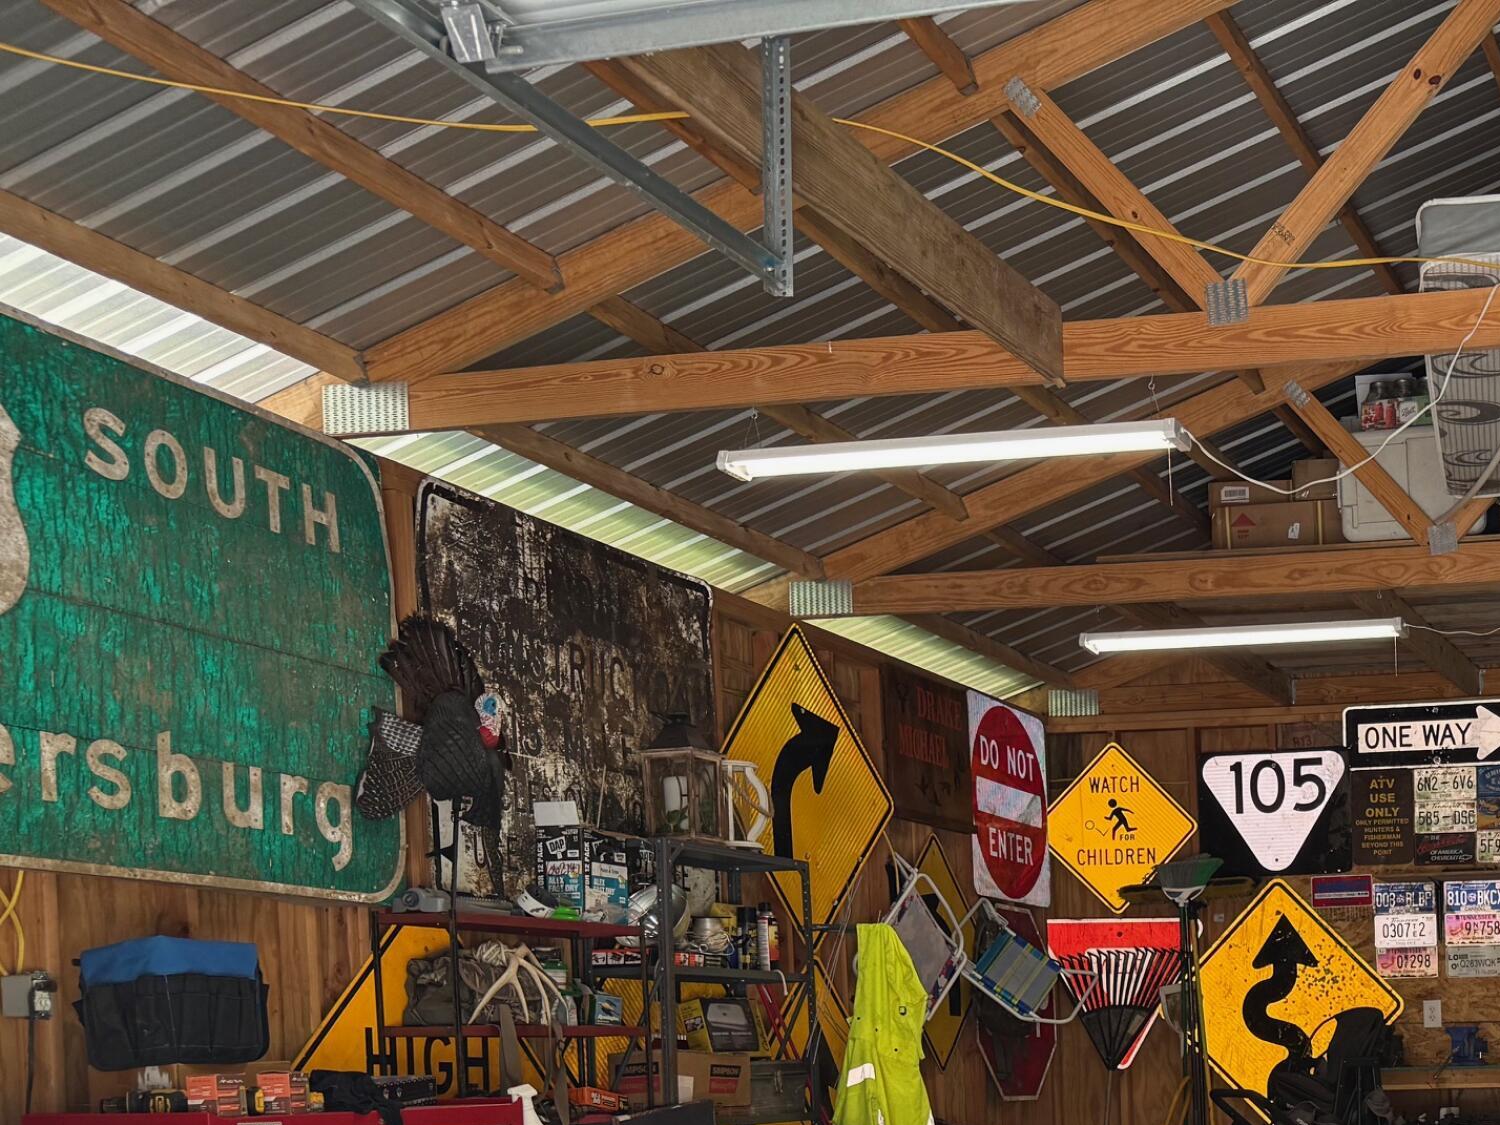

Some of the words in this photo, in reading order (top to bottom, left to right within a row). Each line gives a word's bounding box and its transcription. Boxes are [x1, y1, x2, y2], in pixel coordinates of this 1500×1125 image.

[82, 406, 341, 554] SOUTH
[917, 686, 963, 731] DRAKE
[1365, 722, 1413, 749] ONE
[1422, 720, 1473, 748] WAY
[980, 735, 1000, 770] DO
[1006, 744, 1036, 783] NOT
[1088, 775, 1140, 794] WATCH
[1229, 757, 1327, 815] 105
[1369, 778, 1394, 790] ATV
[1369, 793, 1395, 804] USE
[1365, 807, 1399, 818] ONLY
[1119, 833, 1136, 841] FOR
[988, 829, 1034, 868] ENTER
[1077, 845, 1157, 867] CHILDREN
[1447, 890, 1467, 906] 810
[1382, 922, 1411, 939] 0307
[1480, 921, 1500, 936] 758
[1410, 954, 1432, 969] 298
[364, 1026, 490, 1096] HIGH
